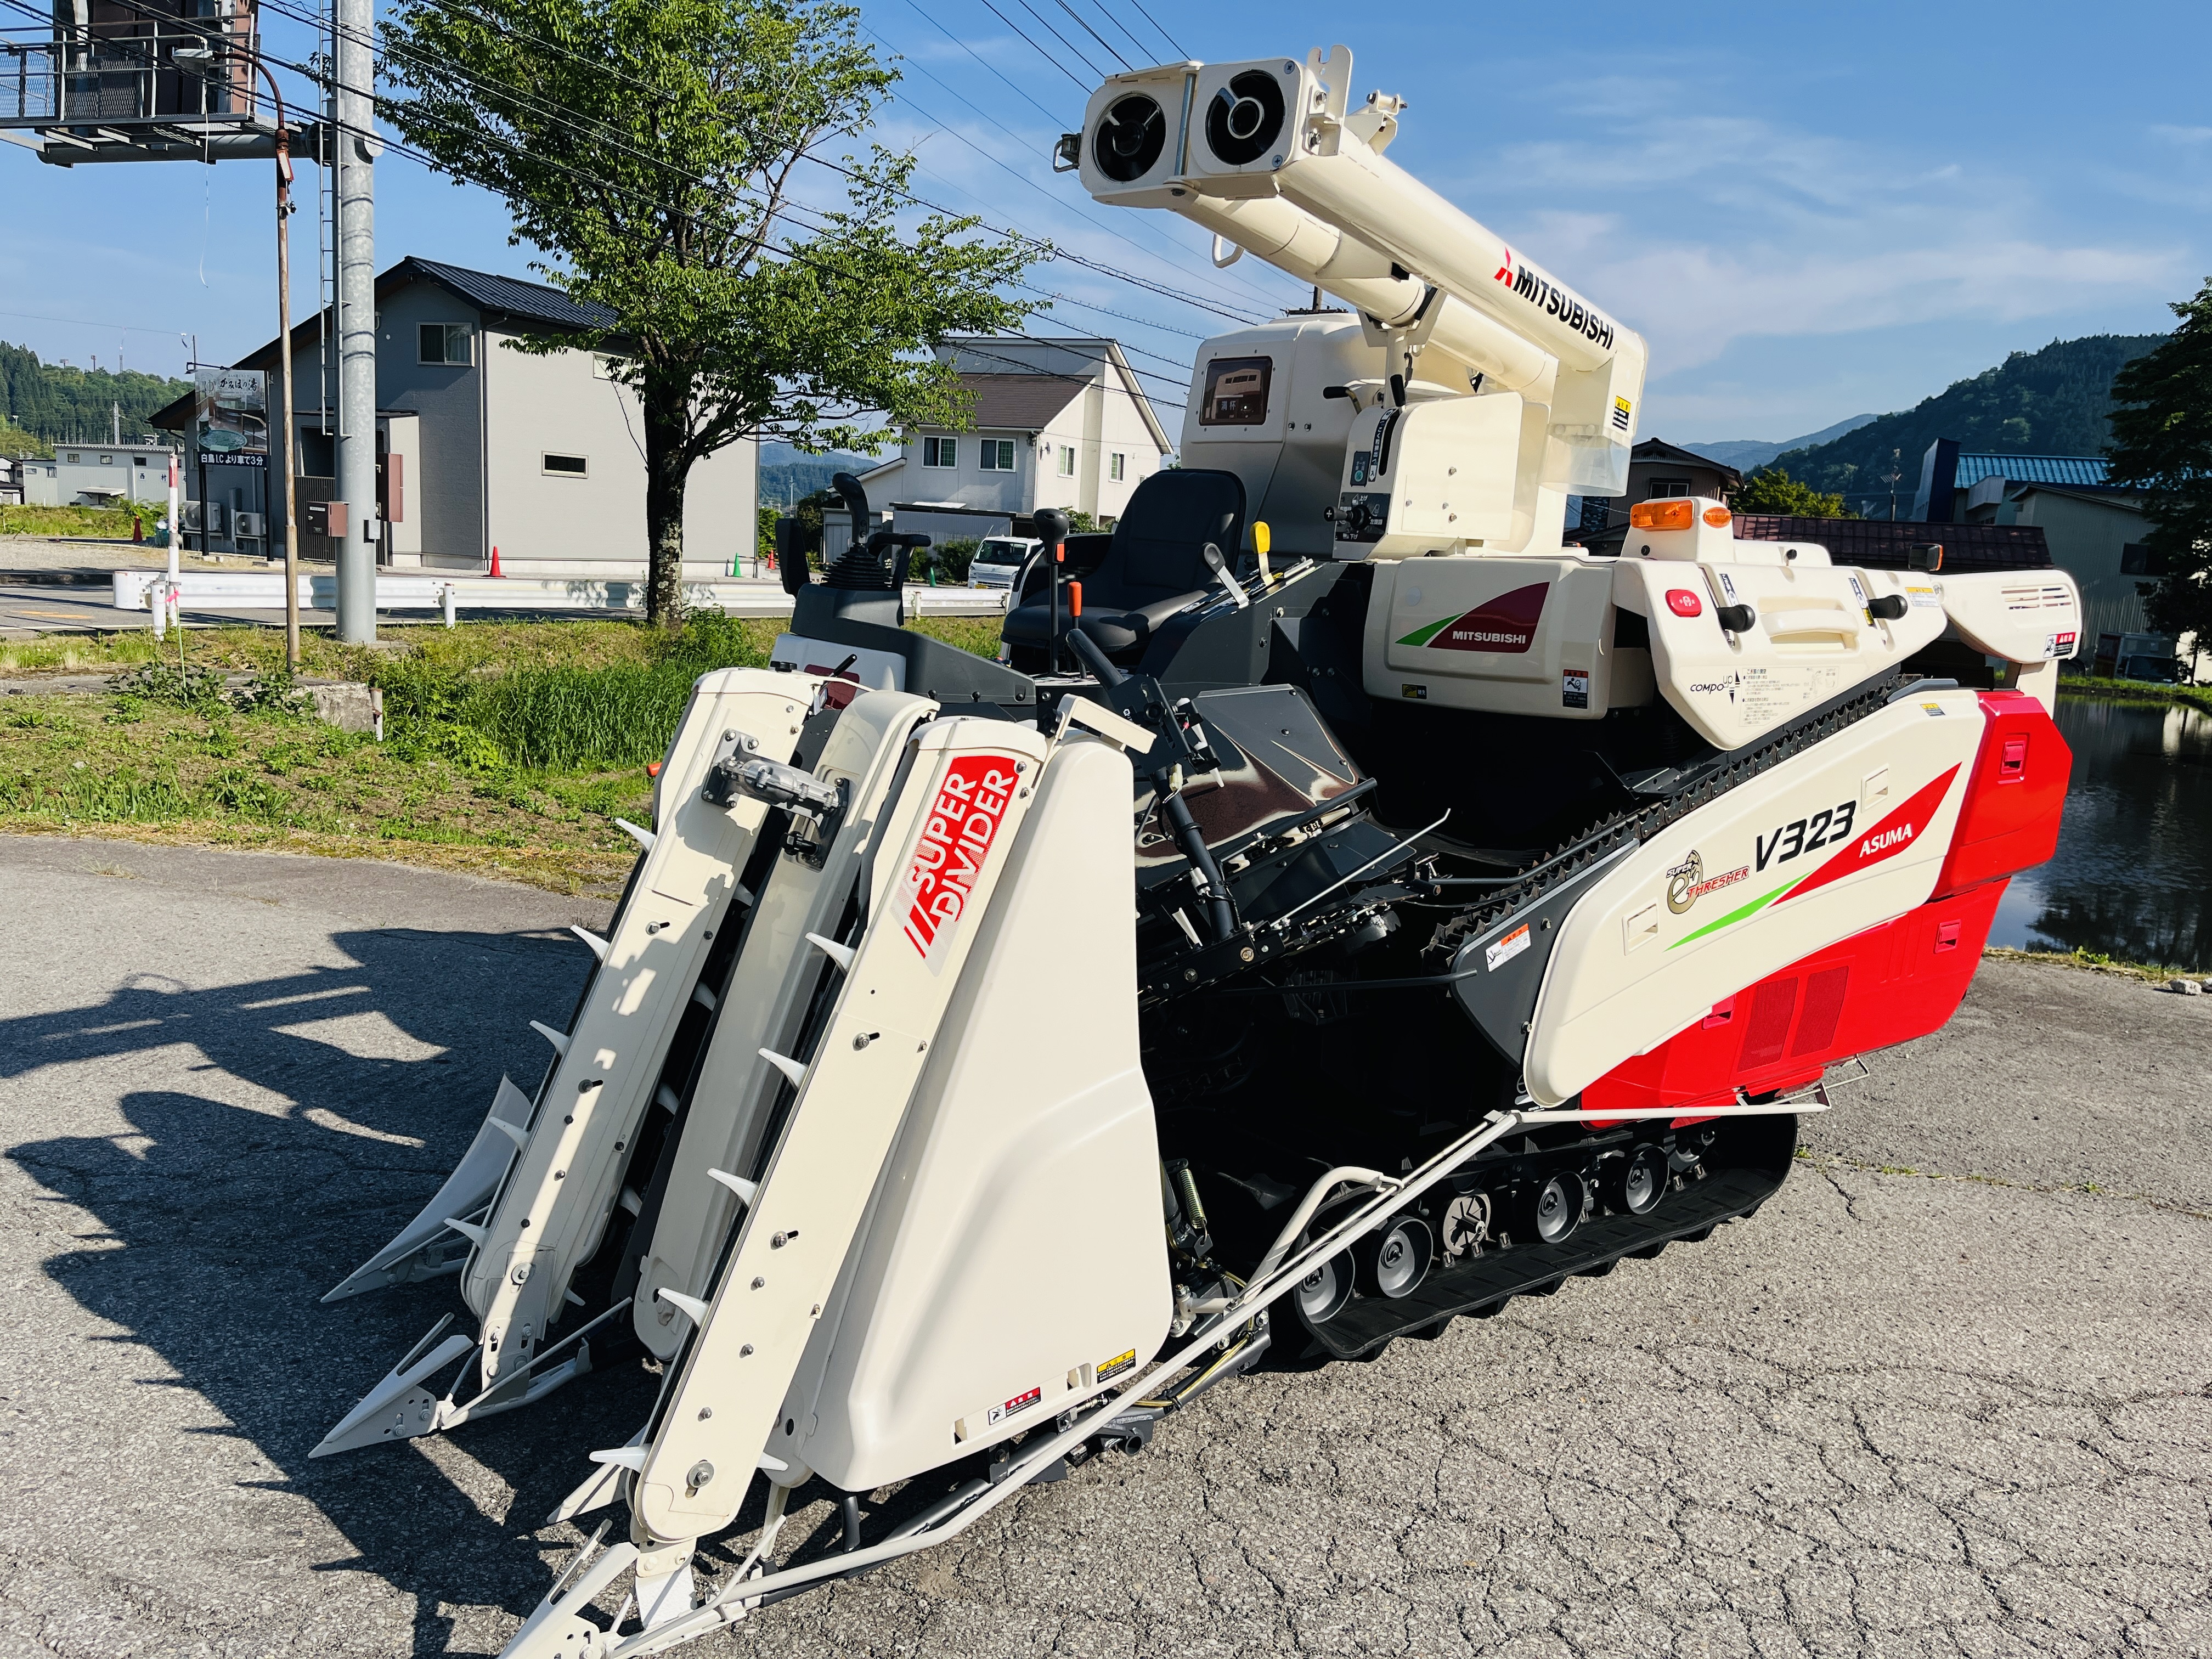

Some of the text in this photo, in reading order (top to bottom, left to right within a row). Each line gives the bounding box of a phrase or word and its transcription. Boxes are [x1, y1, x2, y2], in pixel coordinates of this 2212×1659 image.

[1513, 264, 1614, 350] MITSUBISHI
[1452, 631, 1526, 644] MITSUBISHI
[909, 773, 978, 894] SUPER
[929, 769, 1014, 922] DIVIDER
[1756, 800, 1857, 873] V323
[1859, 823, 1912, 858] ASUMA
[1666, 862, 1693, 878] SUPER
[1688, 868, 1748, 898] THRESHER
